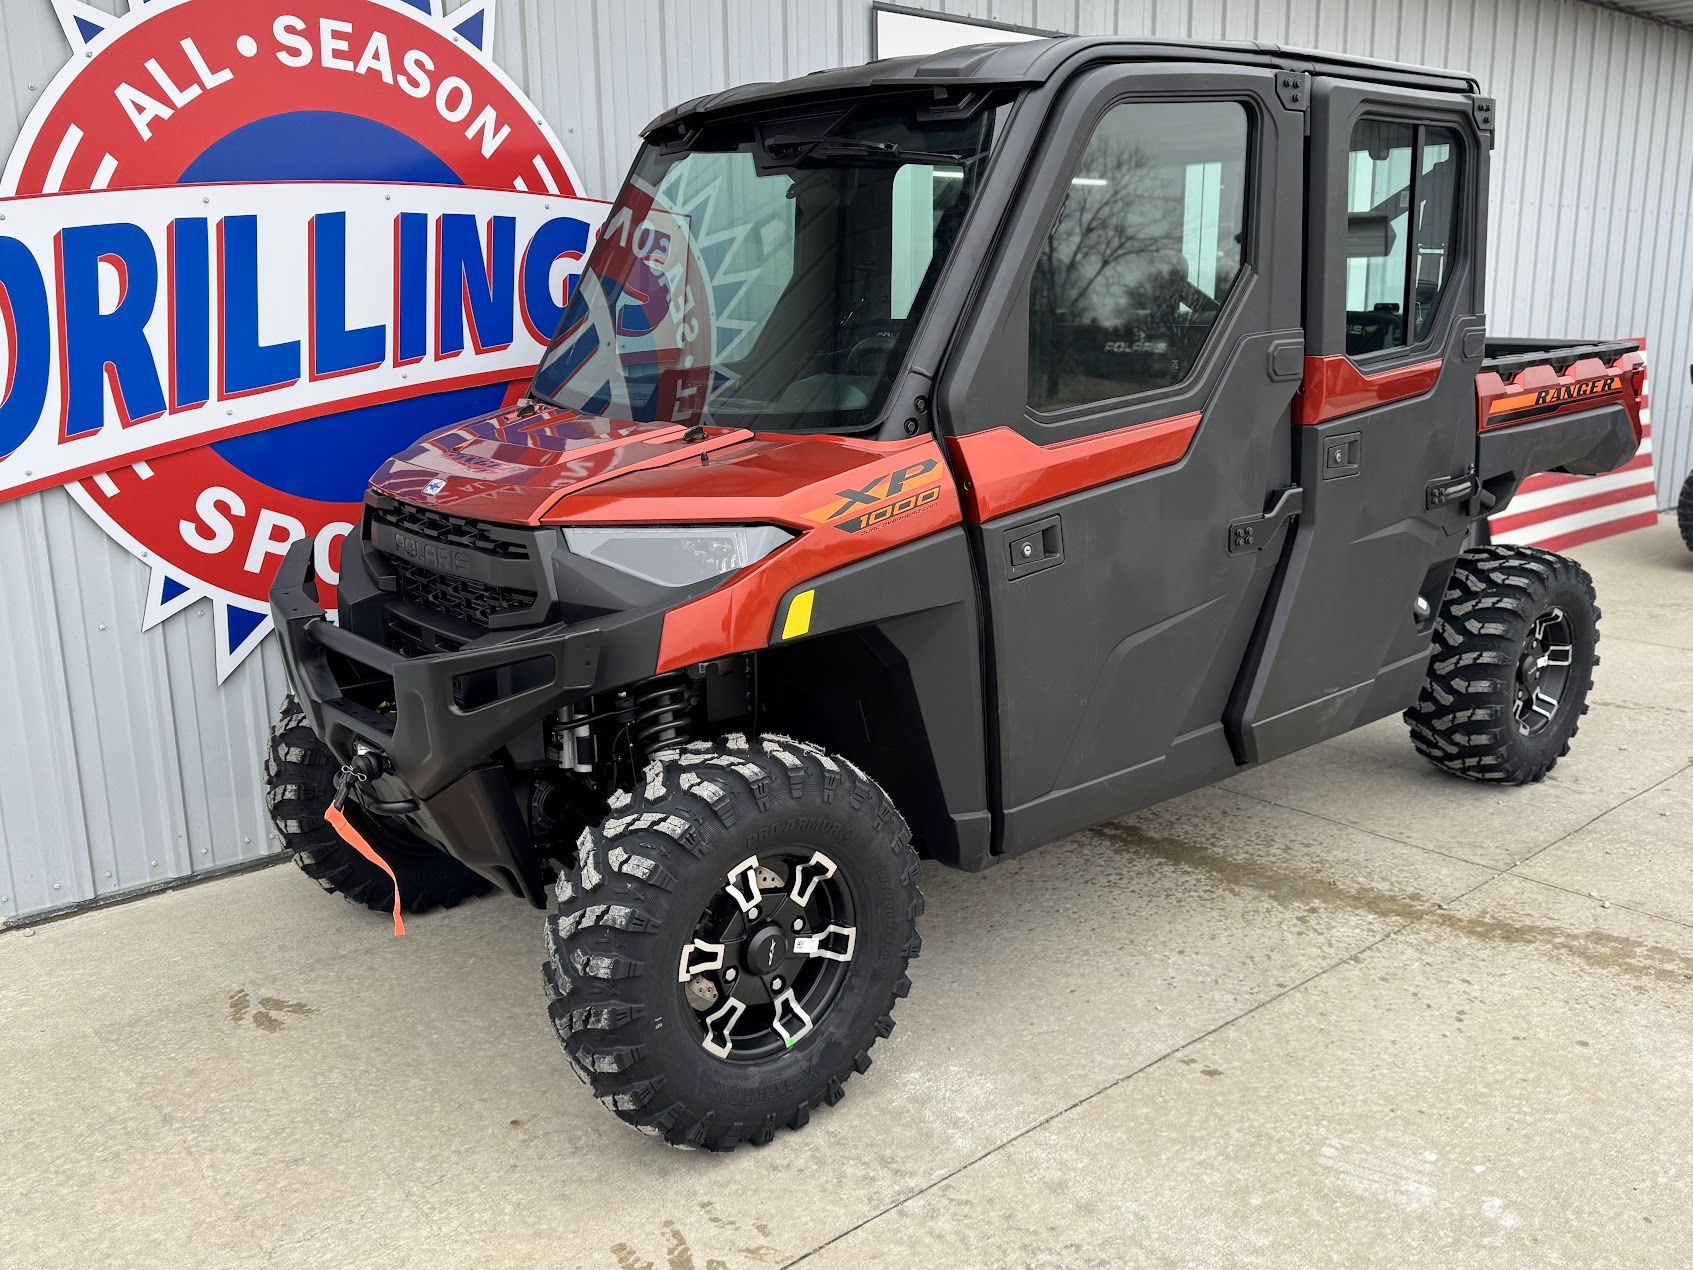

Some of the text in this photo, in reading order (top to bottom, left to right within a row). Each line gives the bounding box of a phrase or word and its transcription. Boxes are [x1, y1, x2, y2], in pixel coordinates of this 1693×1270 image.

[114, 15, 511, 159] ALL SEASON
[1534, 377, 1615, 405] RANGER
[826, 458, 938, 521] XP
[860, 486, 940, 529] 1000
[395, 532, 472, 571] POLARIS
